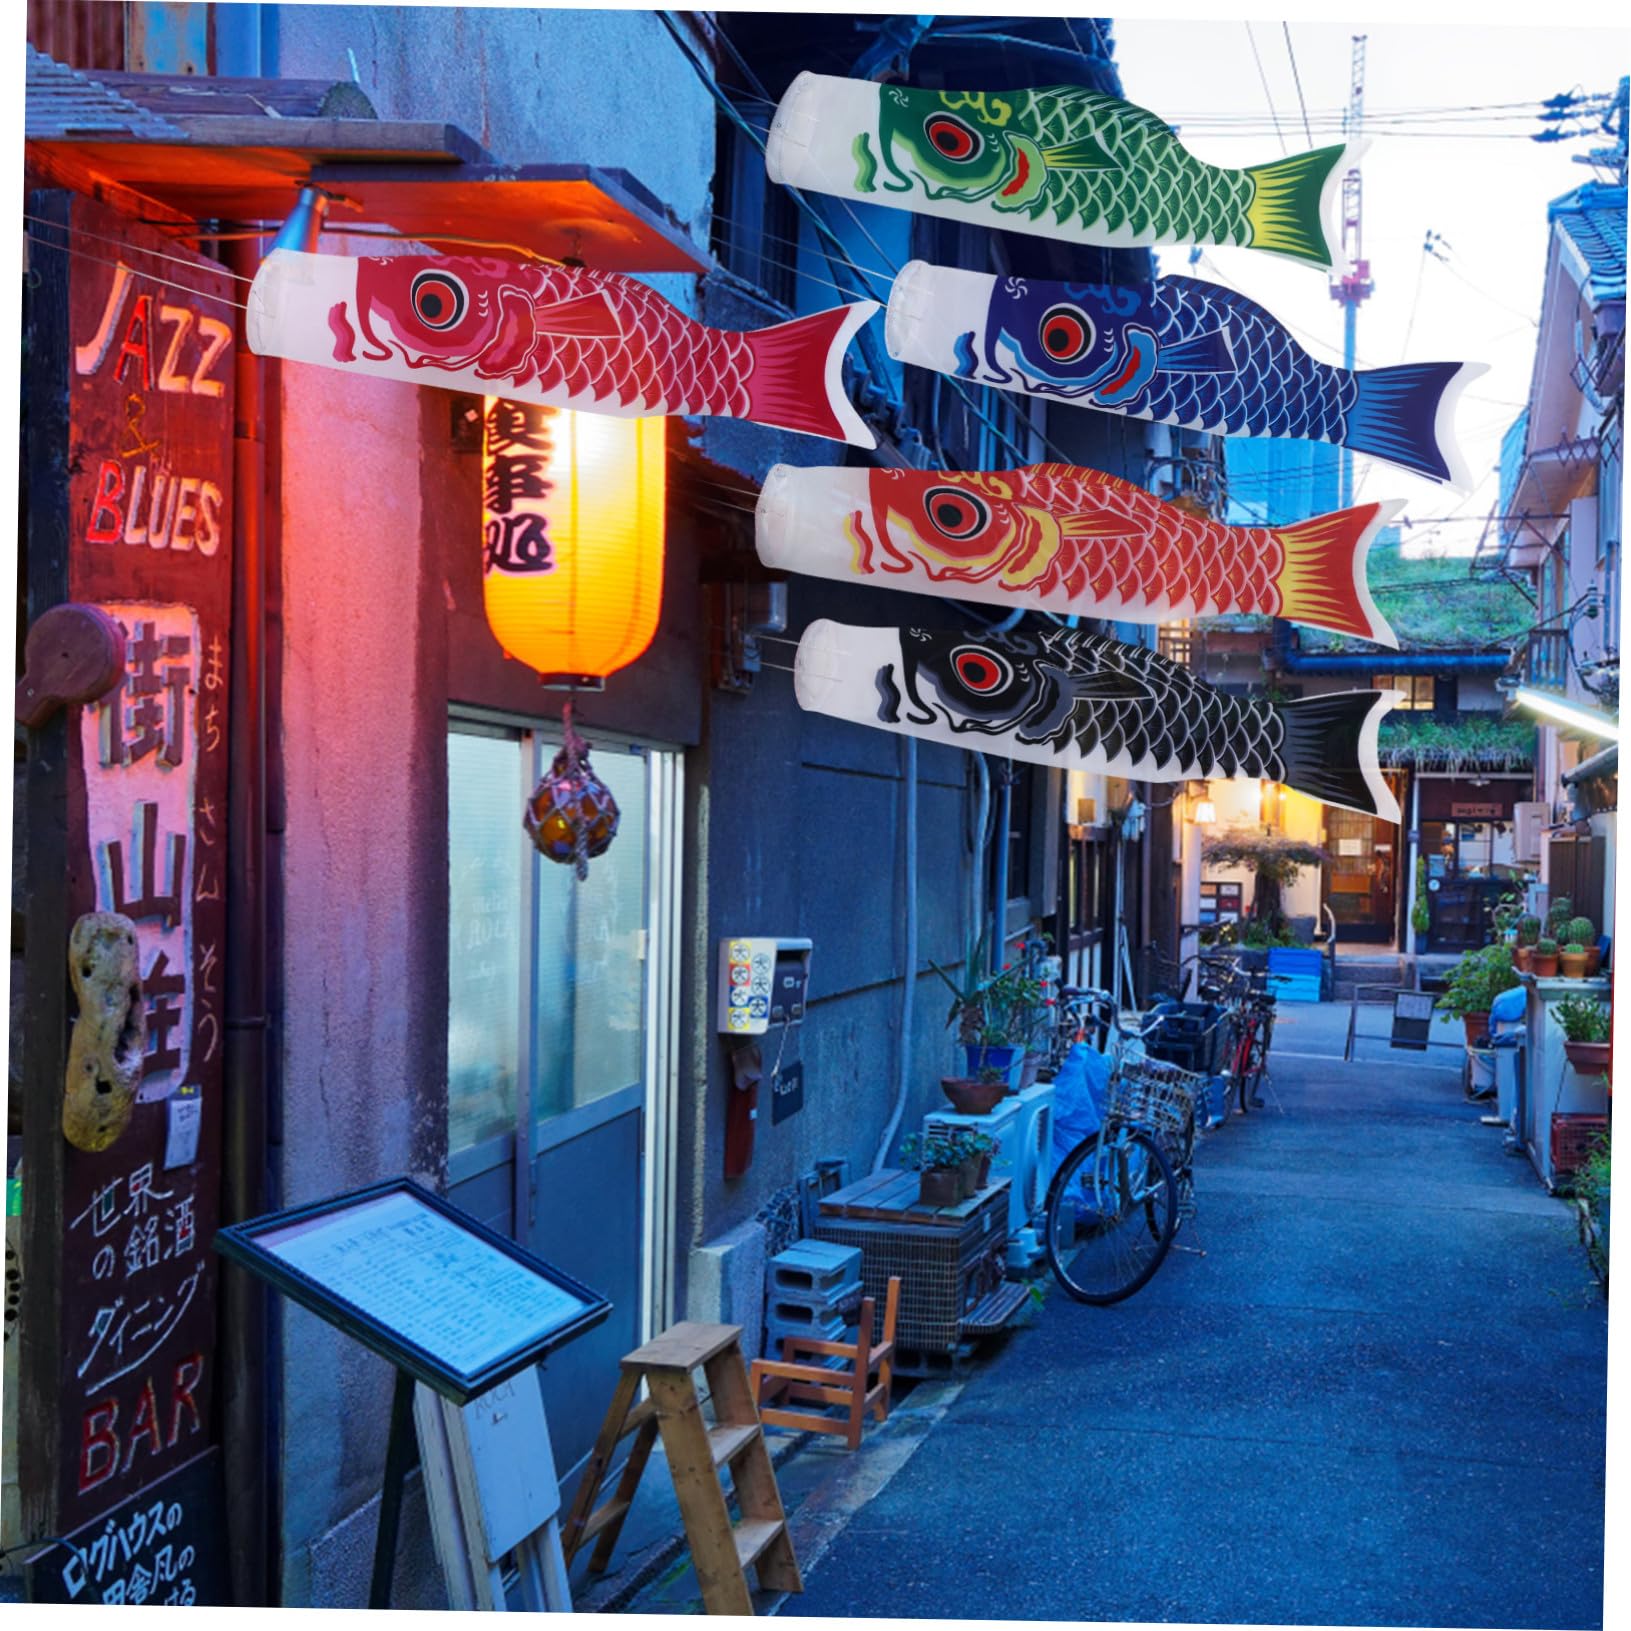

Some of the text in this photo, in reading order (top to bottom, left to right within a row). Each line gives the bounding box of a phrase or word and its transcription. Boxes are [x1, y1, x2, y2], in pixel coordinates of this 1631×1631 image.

[75, 260, 233, 398] JAZZ
[85, 459, 223, 556] BLUES
[69, 1162, 175, 1237] 世界
[92, 1193, 196, 1280] の銘酒
[76, 1258, 206, 1397] ダイニング
[77, 1353, 203, 1496] BAR
[61, 1501, 183, 1599] ログハウスの
